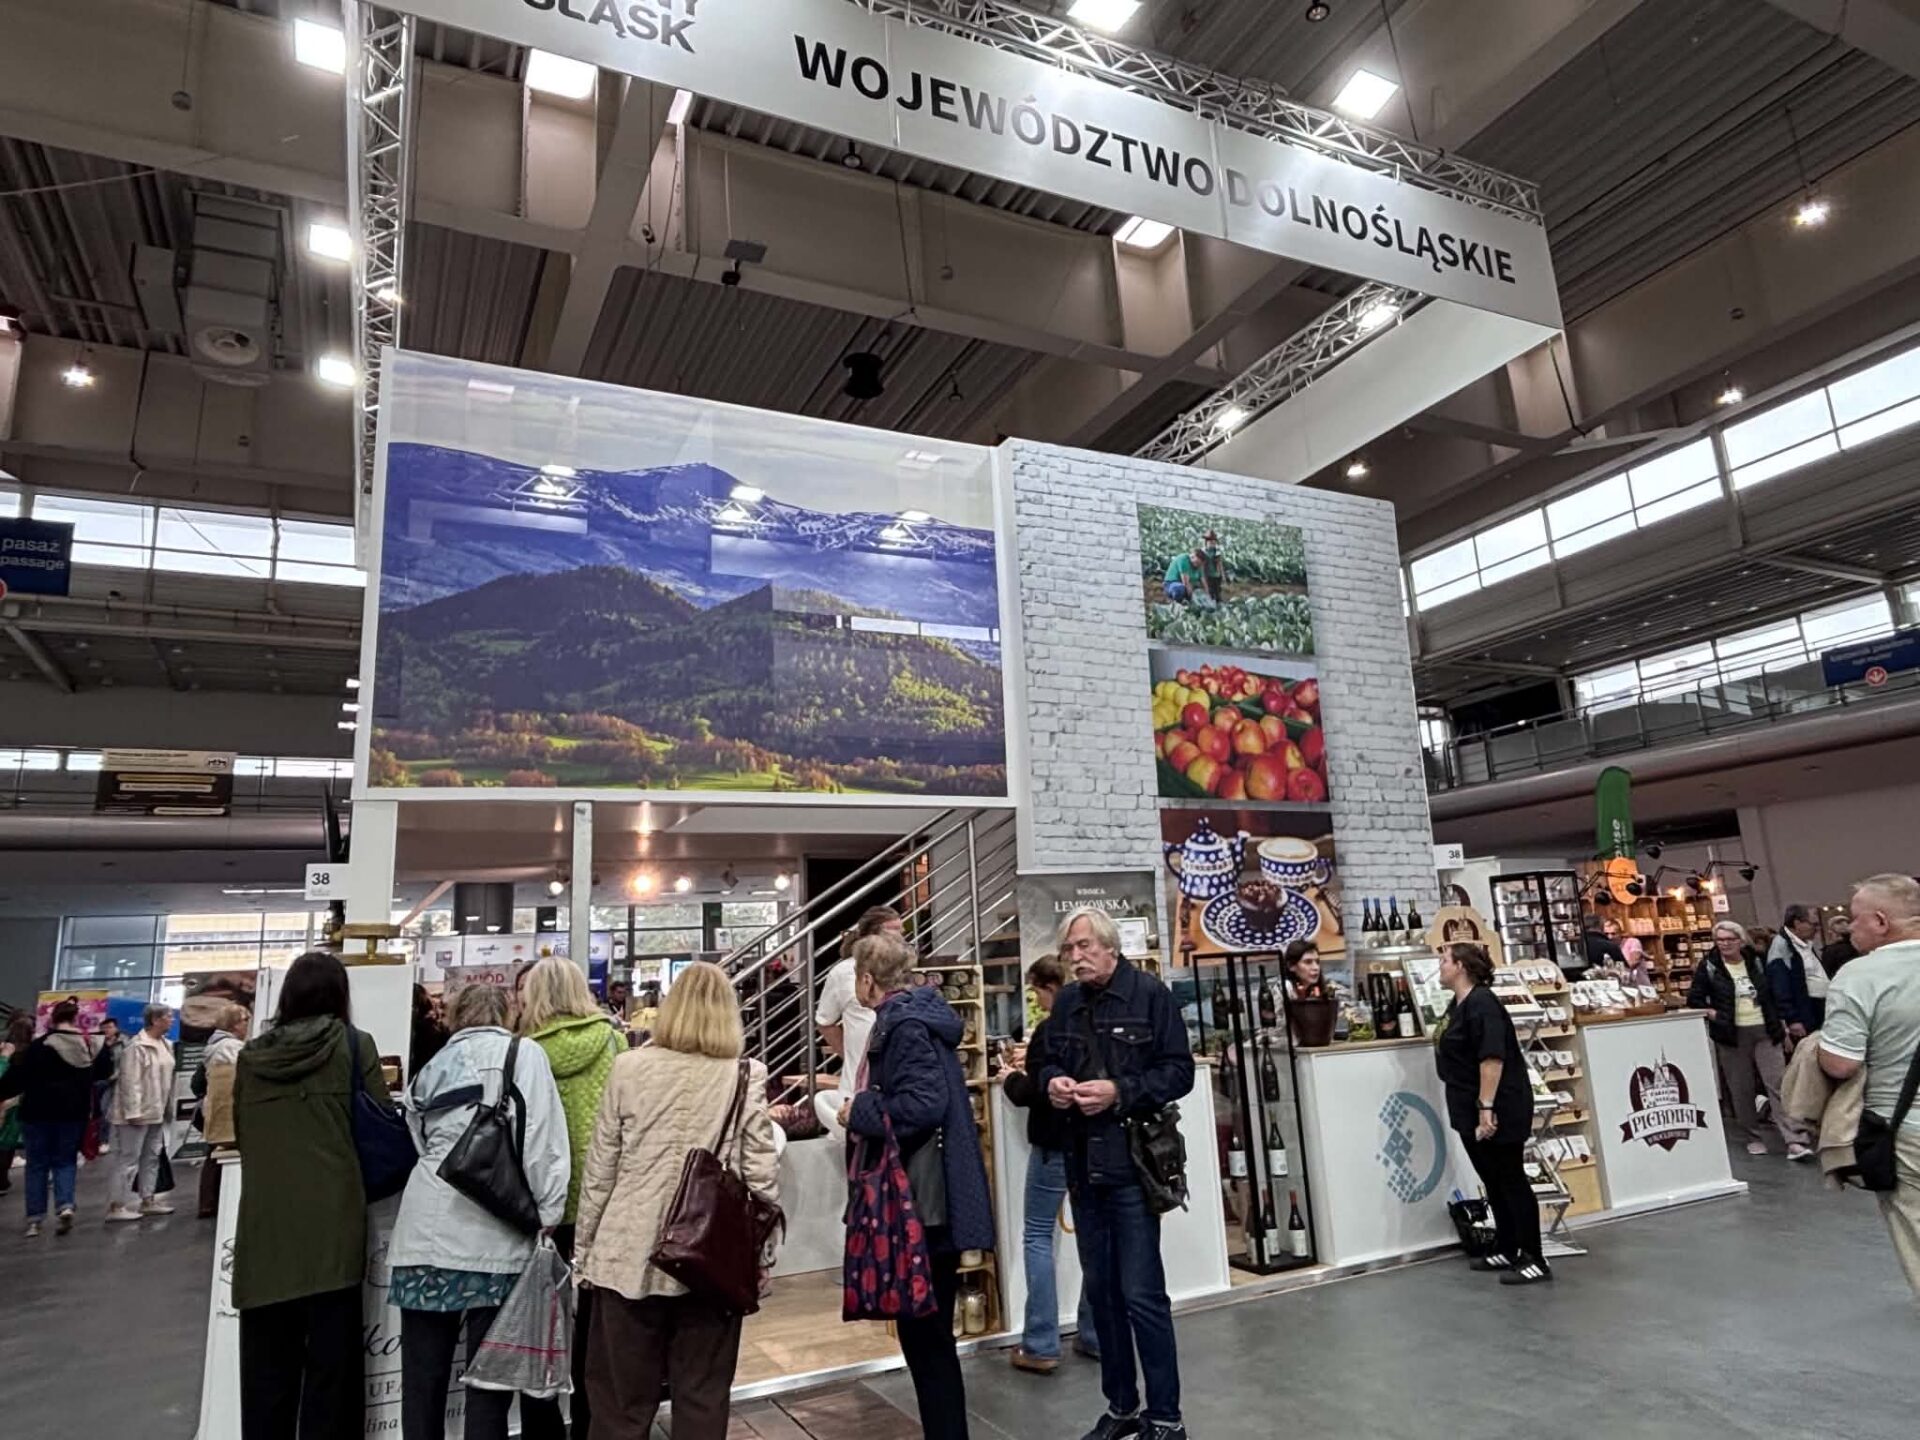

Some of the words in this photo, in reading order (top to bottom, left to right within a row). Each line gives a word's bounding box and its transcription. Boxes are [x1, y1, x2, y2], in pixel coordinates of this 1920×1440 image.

[794, 34, 1214, 197] WOJEWÓDZTWO
[1226, 168, 1516, 284] DOLNOŚLĄSKIE
[0, 556, 65, 571] passage
[1447, 849, 1461, 859] 38
[311, 872, 330, 886] 38
[1632, 1109, 1695, 1133] PIERNIKI
